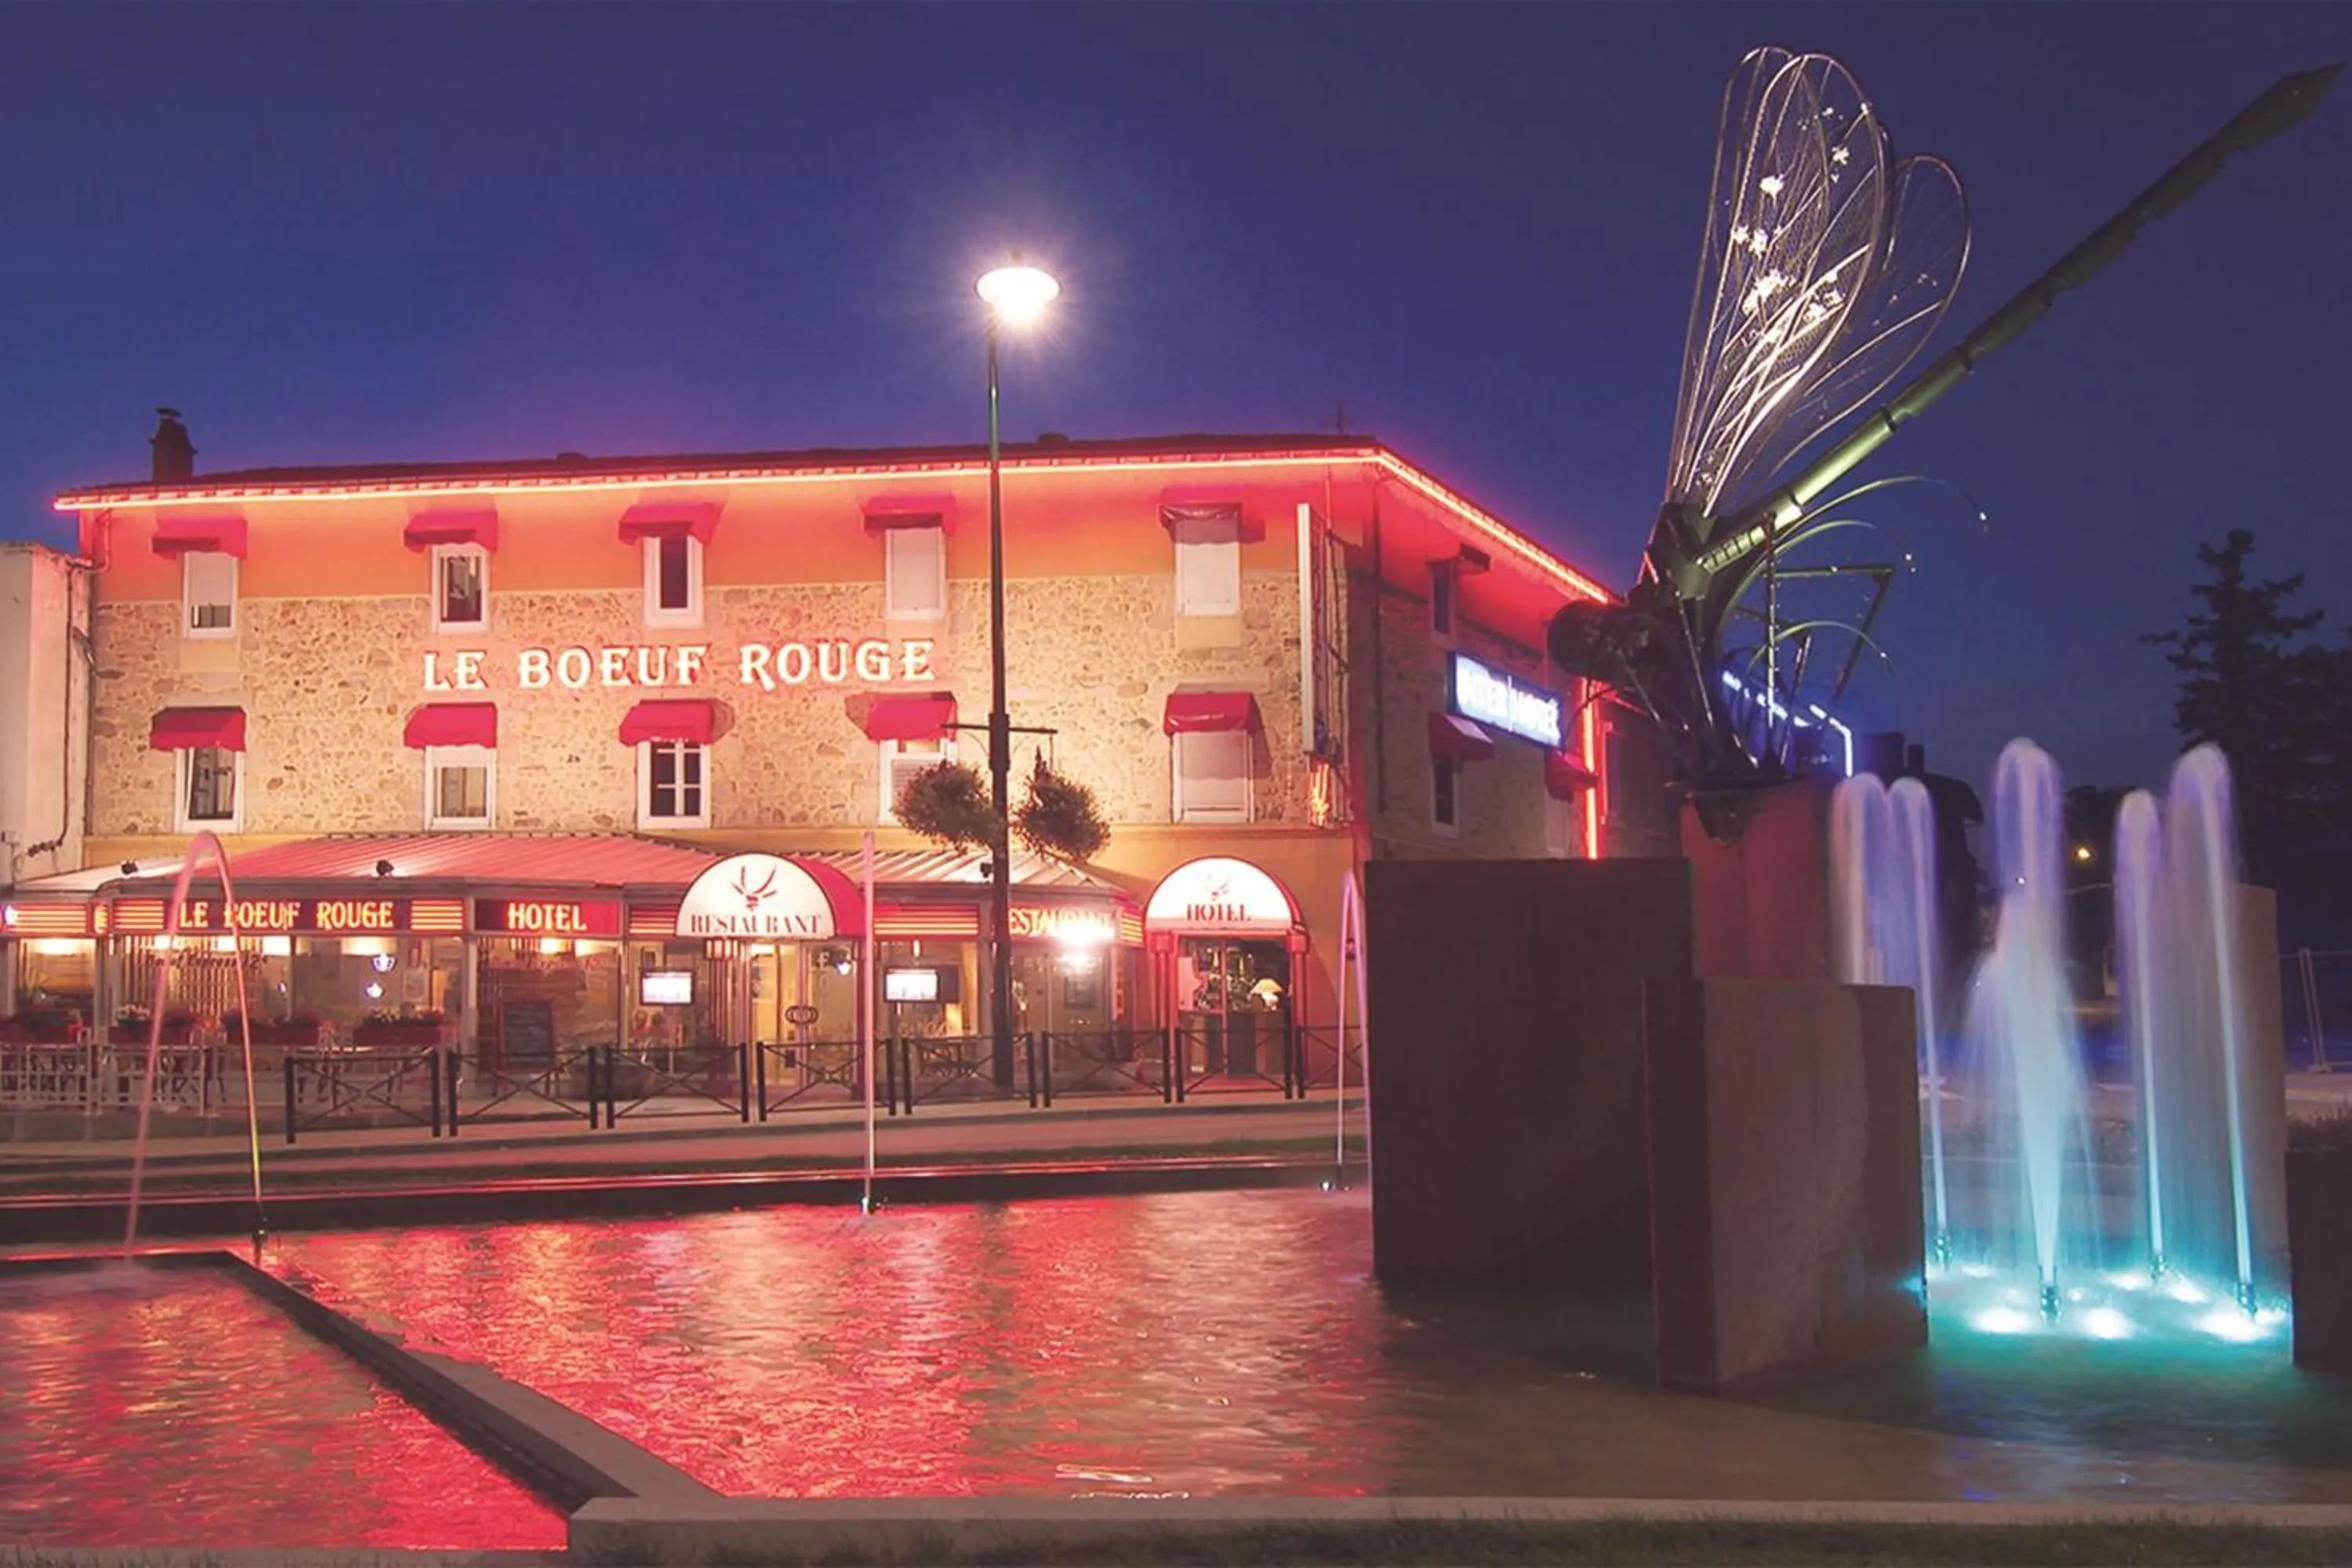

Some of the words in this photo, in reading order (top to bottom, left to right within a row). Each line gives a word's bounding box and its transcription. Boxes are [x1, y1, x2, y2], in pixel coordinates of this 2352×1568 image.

[423, 650, 488, 691] LE
[517, 644, 710, 688] BOEUF
[738, 638, 937, 691] ROUGE
[178, 902, 209, 928] LE
[223, 901, 301, 930] BOEUF
[316, 901, 394, 931] ROUGE
[507, 902, 587, 931] HOTEL
[690, 913, 822, 934] RESTAURANT
[1008, 907, 1114, 941] ESTAURANT
[1186, 902, 1253, 923] HOTEL
